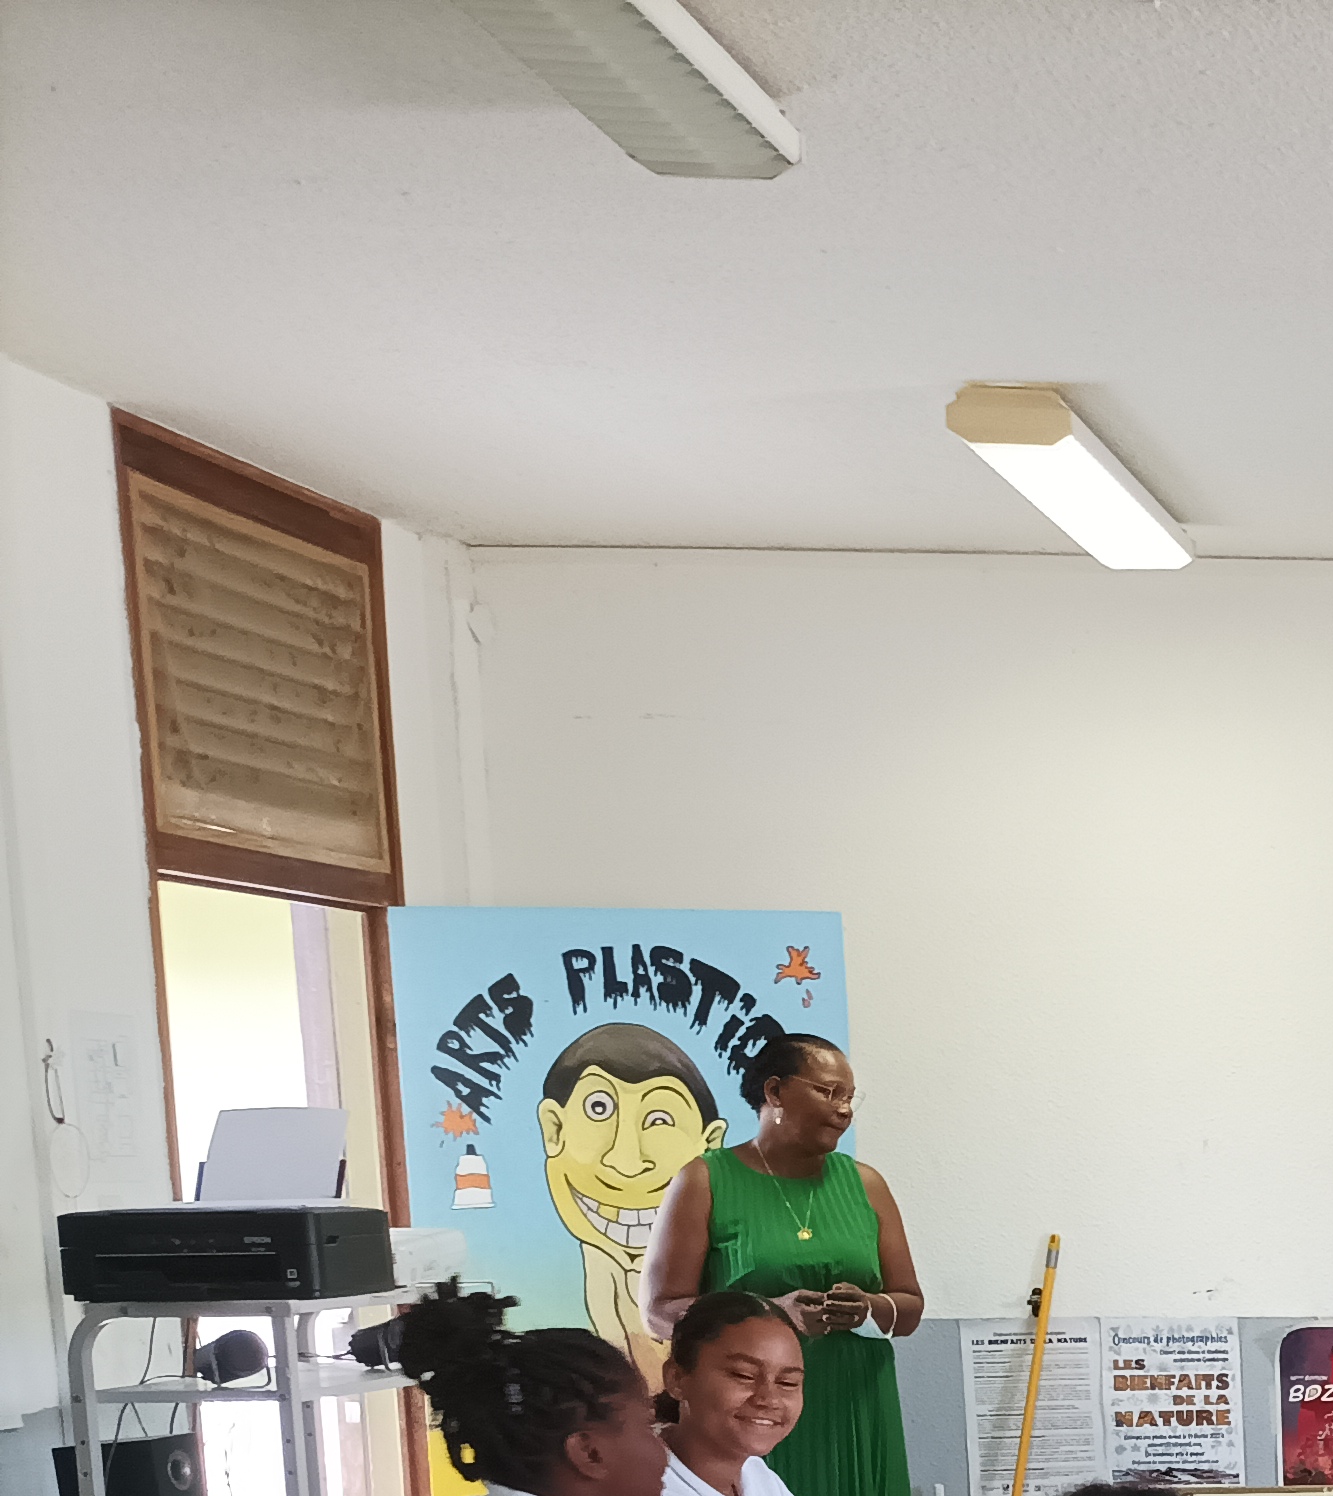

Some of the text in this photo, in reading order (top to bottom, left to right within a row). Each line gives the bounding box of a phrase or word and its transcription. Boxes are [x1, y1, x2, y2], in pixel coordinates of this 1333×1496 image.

[431, 973, 534, 1125] ARTS
[1112, 1333, 1151, 1346] Concours
[1166, 1333, 1229, 1347] photographies
[1112, 1358, 1146, 1371] LES
[1113, 1373, 1230, 1392] BIENFAITS
[1172, 1394, 1230, 1406] DE LA
[1114, 1408, 1232, 1428] NATURE
